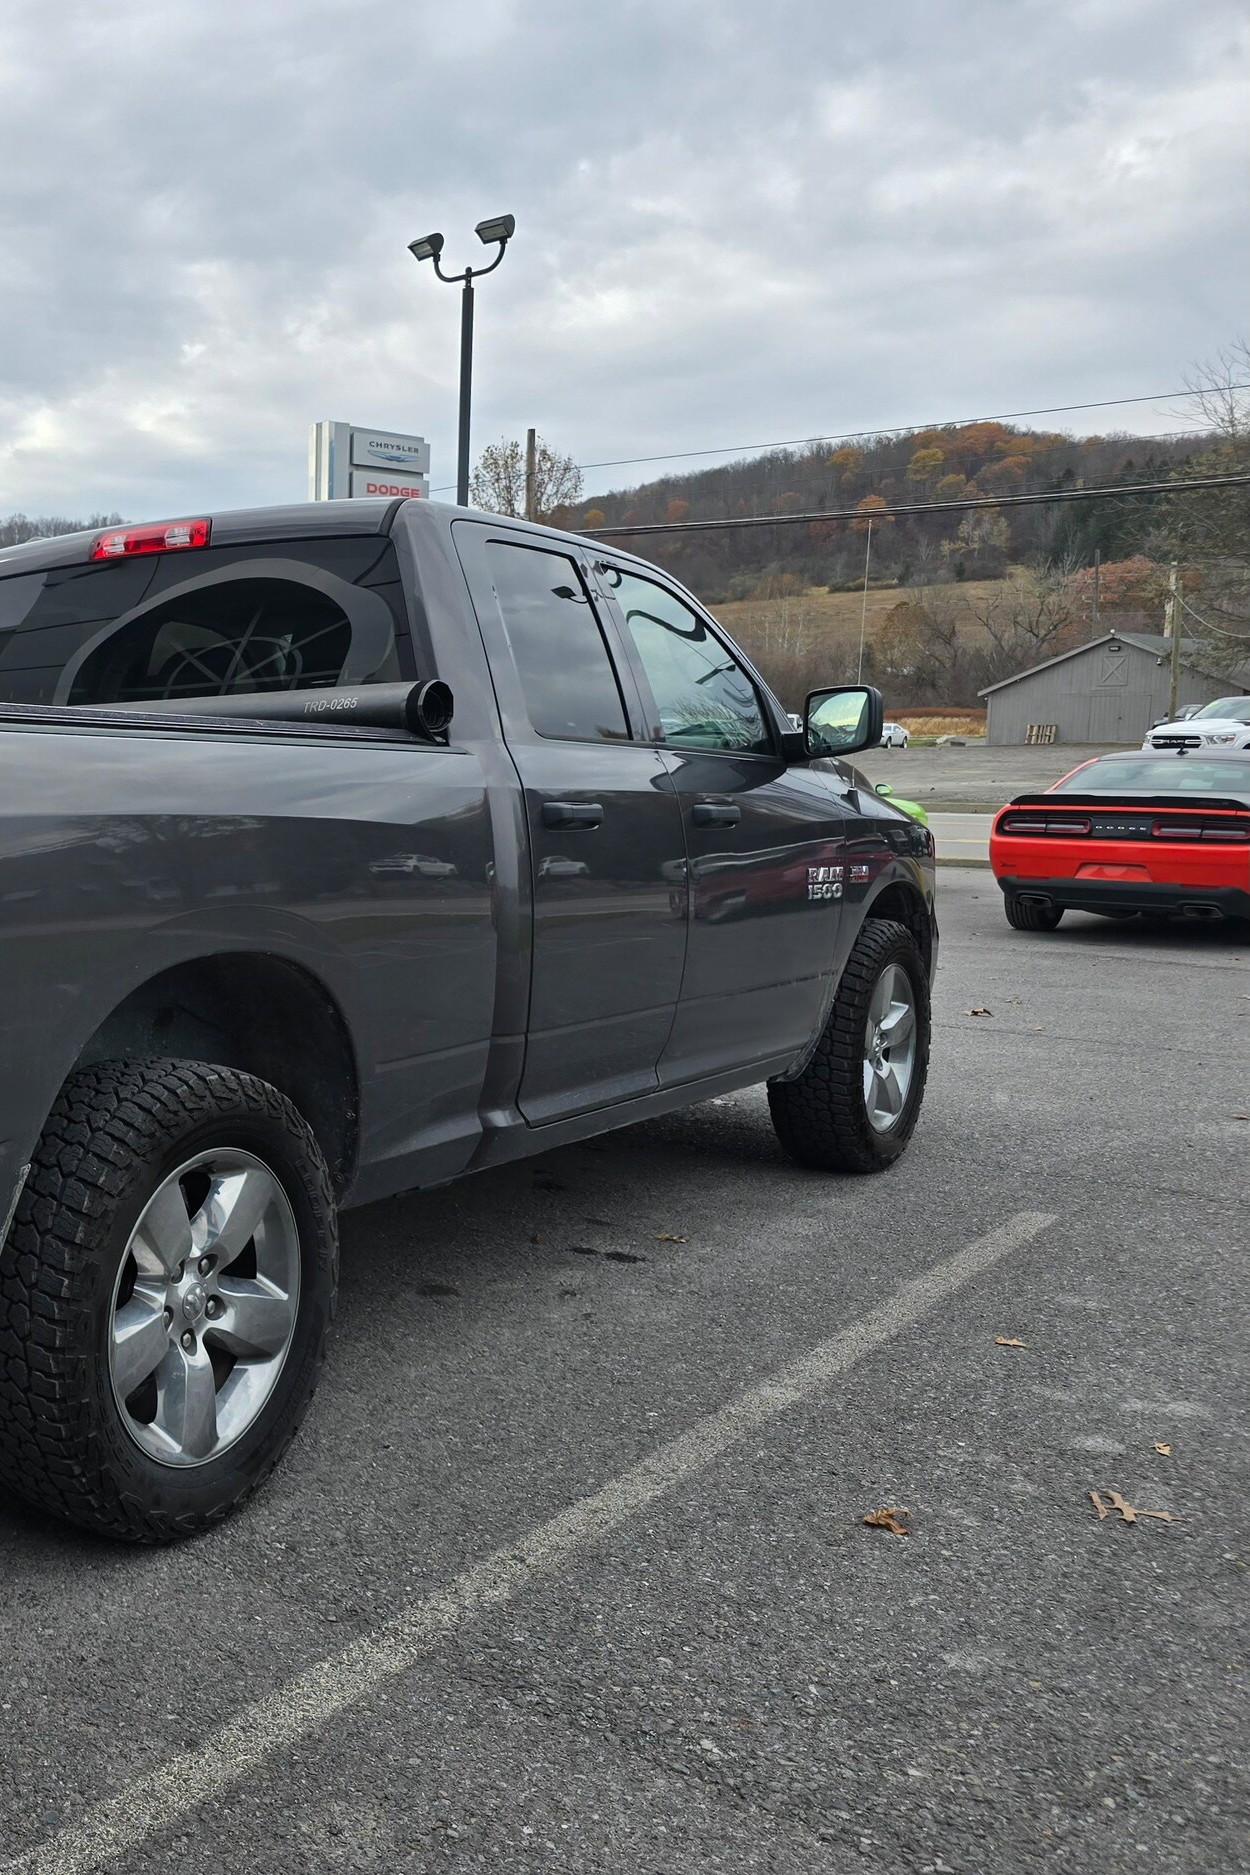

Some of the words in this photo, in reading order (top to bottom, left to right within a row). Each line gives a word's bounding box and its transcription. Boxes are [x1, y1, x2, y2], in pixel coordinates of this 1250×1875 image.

[369, 440, 419, 454] CHRYSLER
[366, 482, 420, 498] DODGE
[304, 697, 358, 714] TRD-0265
[808, 866, 843, 882] RAM
[808, 883, 843, 900] 1500
